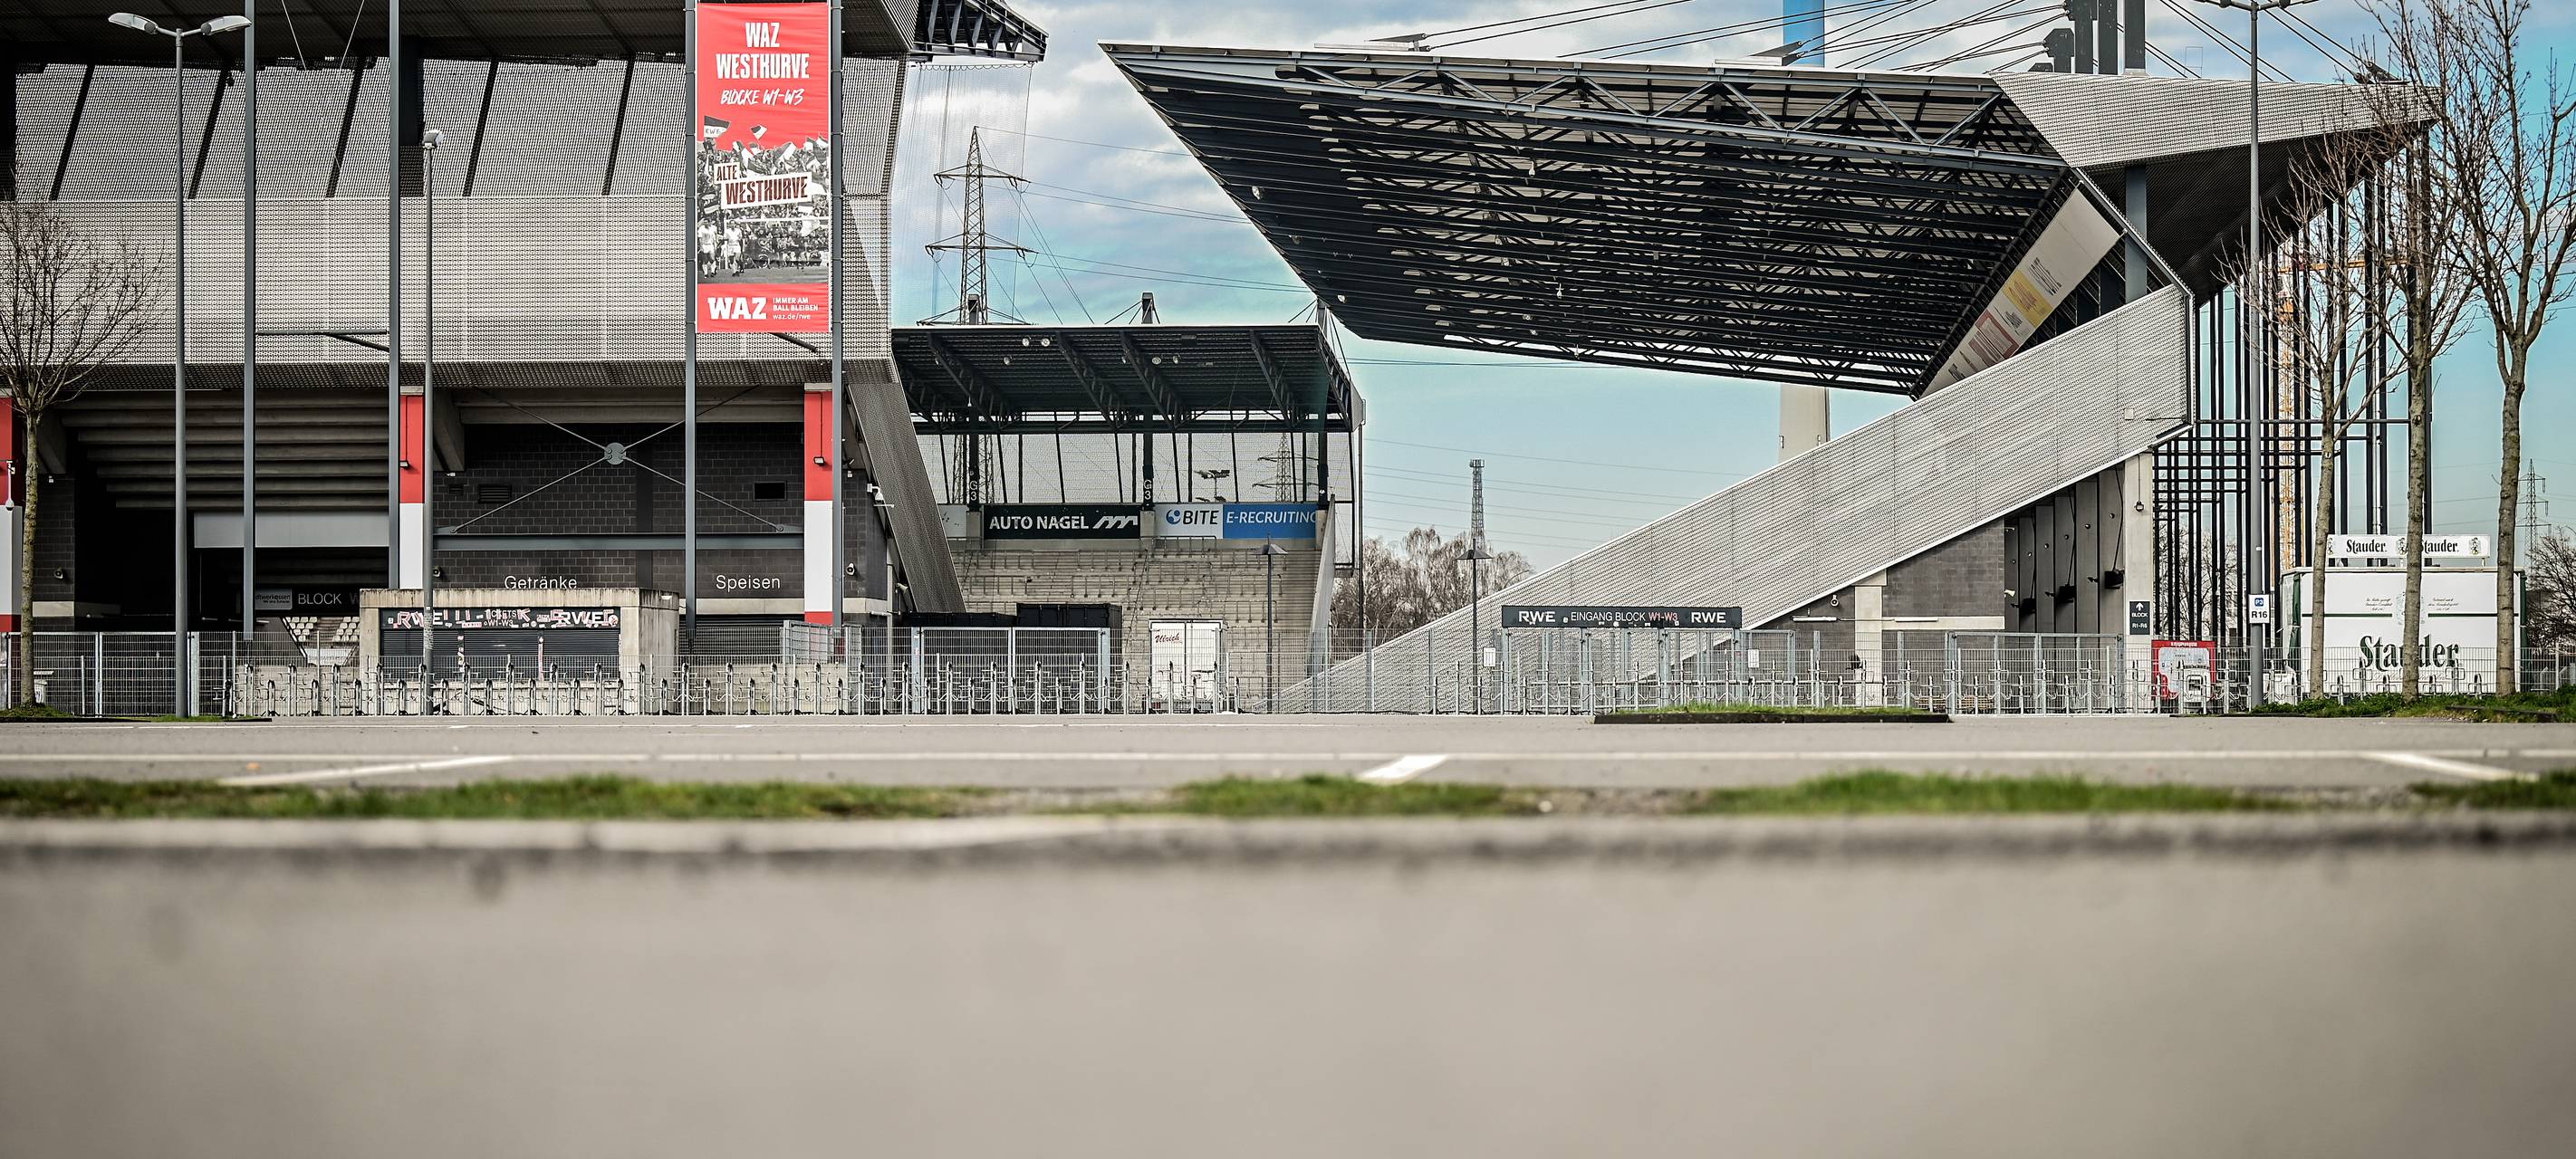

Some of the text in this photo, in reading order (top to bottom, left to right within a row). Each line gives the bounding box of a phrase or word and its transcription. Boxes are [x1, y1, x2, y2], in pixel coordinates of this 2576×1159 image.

[745, 22, 781, 48] WAZ
[716, 53, 810, 80] WESTKURVE
[763, 88, 805, 106] W1-W3
[716, 164, 738, 181] ALTE
[726, 176, 808, 206] WESTKURVE
[707, 296, 767, 320] WAZ
[772, 312, 812, 321] waz.de/rwe
[989, 515, 1090, 530] AUTO NAGEL
[1182, 510, 1220, 525] BITE
[2346, 539, 2386, 554] Stauder
[504, 575, 578, 589] Getränke
[716, 574, 781, 592] Speisen
[298, 592, 342, 605] BLOCK
[1518, 610, 1726, 623] RWE EINGANG BLOCK W1-W3 RWE
[2251, 610, 2268, 618] R16
[2360, 634, 2459, 672] Stader
